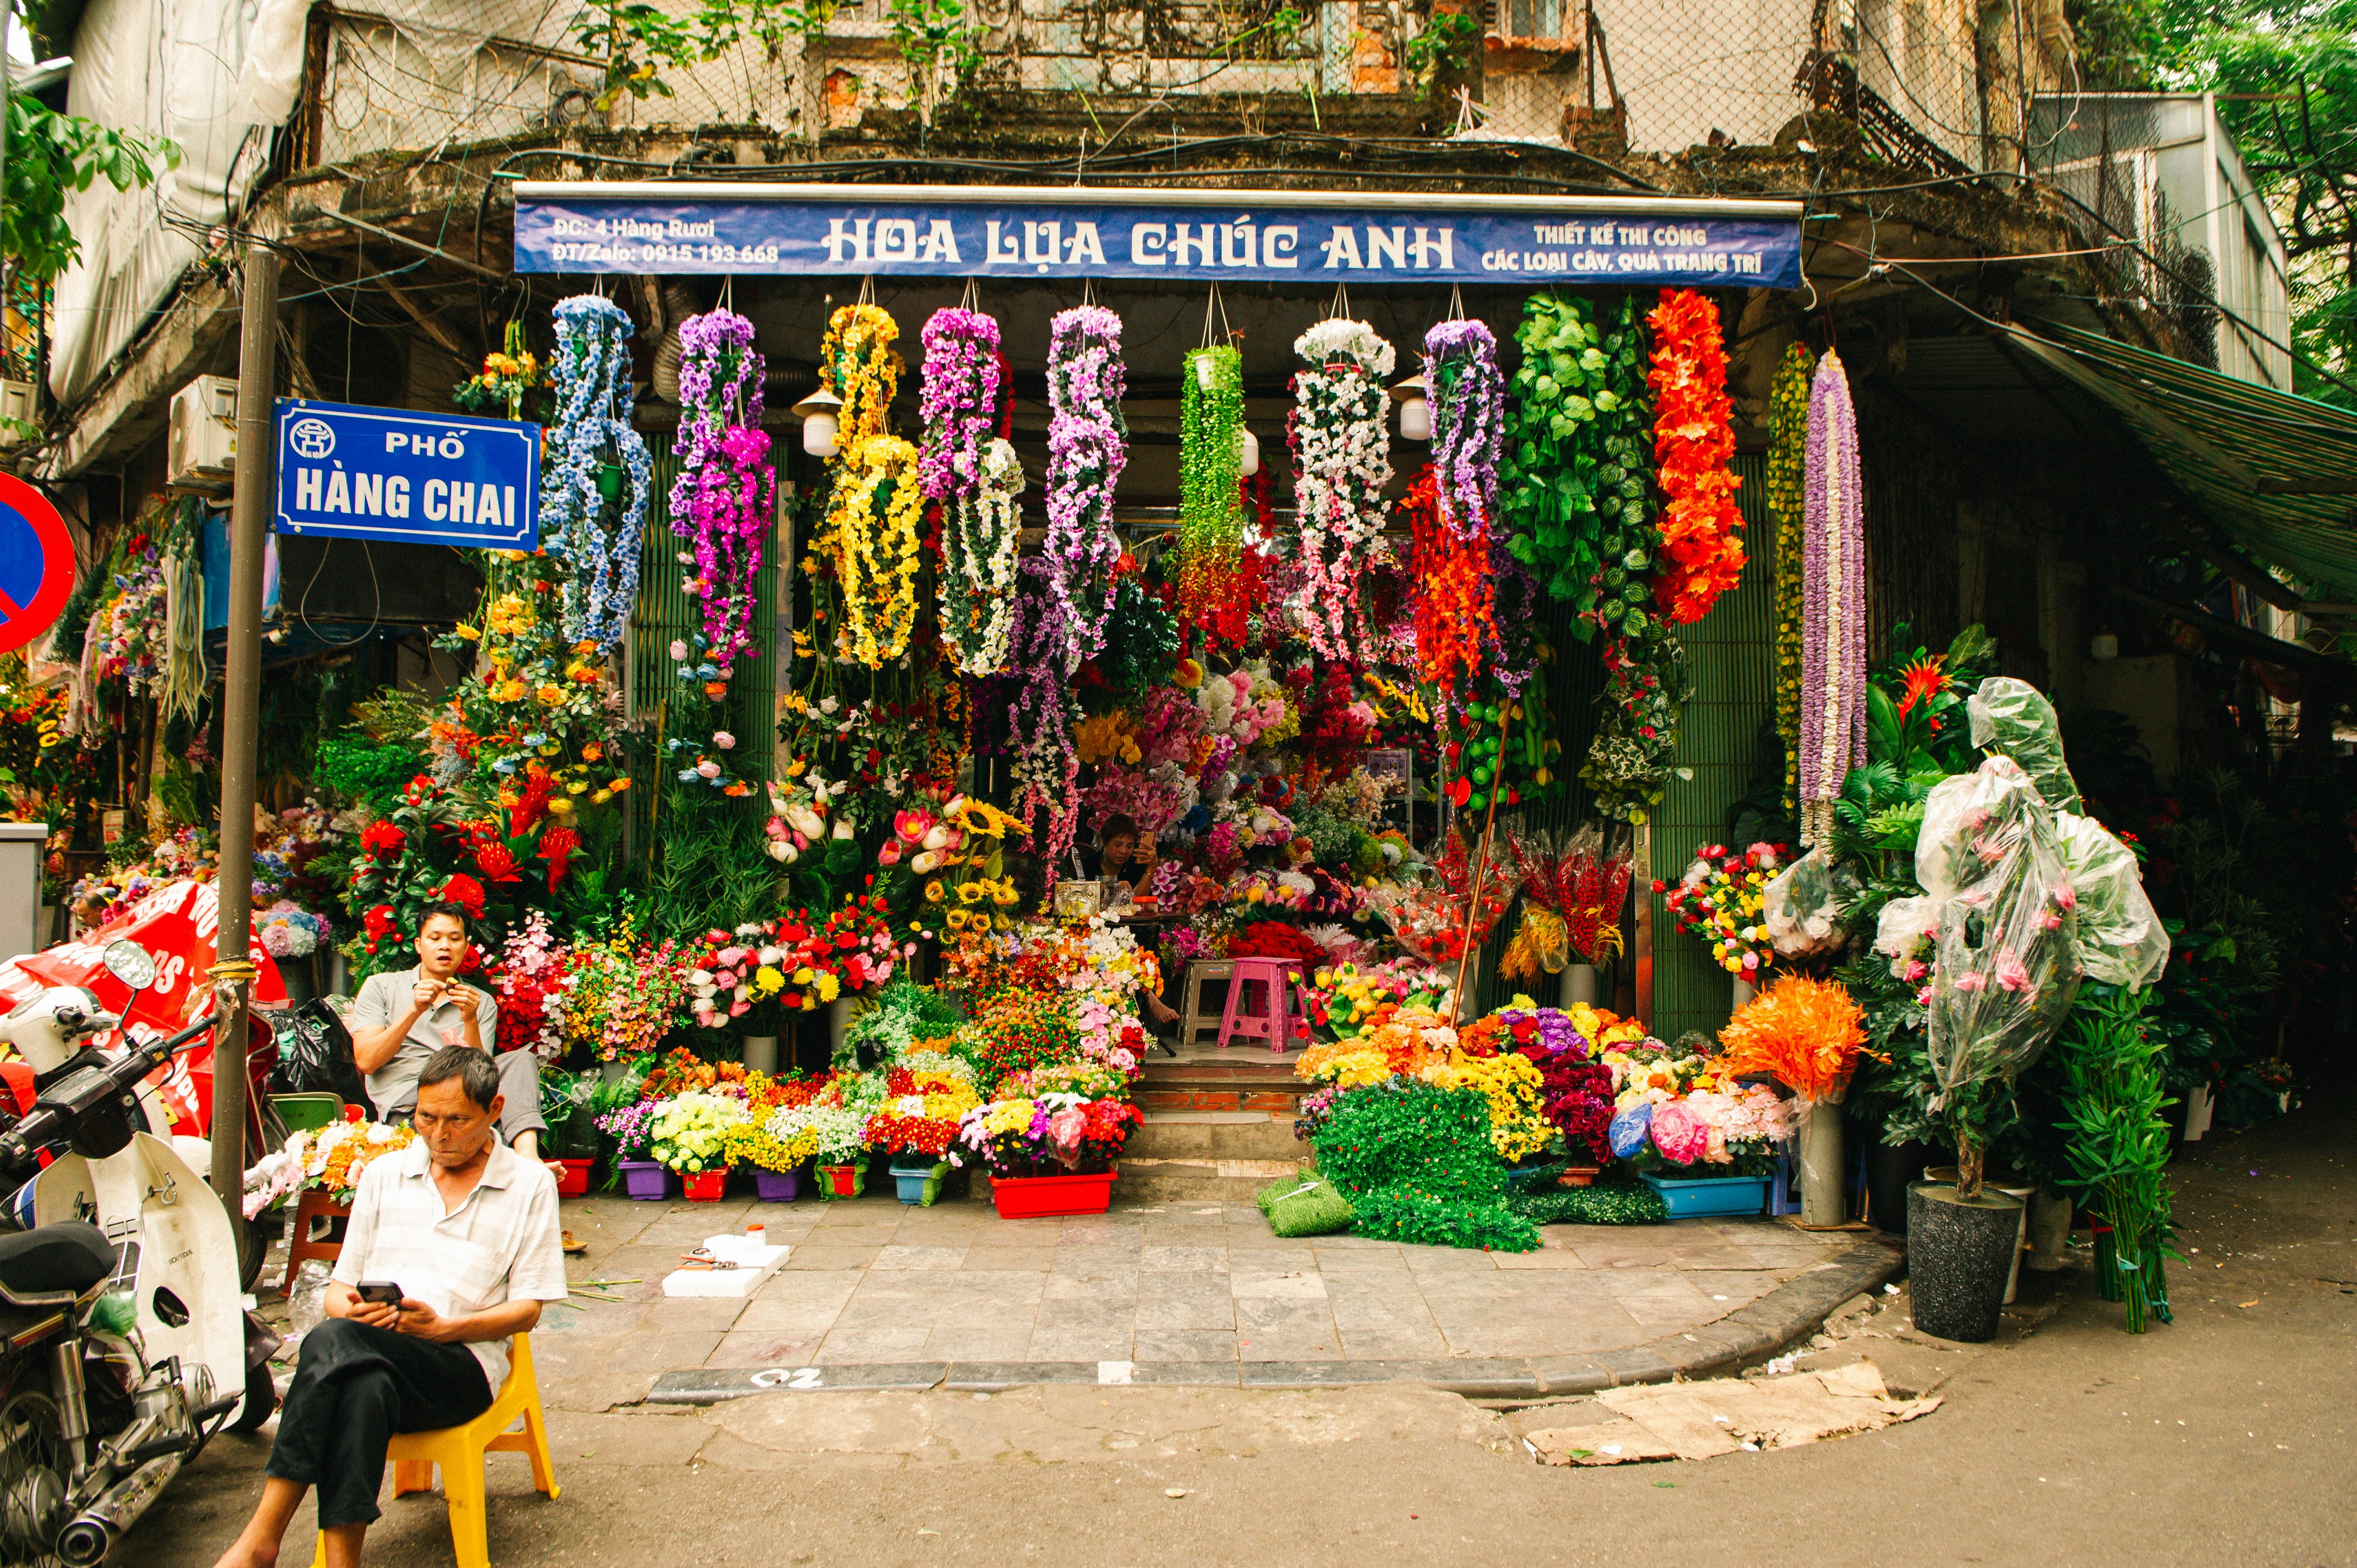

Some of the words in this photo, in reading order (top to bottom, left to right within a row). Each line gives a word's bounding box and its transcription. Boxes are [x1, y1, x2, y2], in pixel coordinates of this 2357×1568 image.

[553, 219, 589, 236] ĐC:
[594, 219, 607, 236] 4
[613, 218, 664, 241] Hàng
[669, 219, 715, 237] Rươi
[1533, 220, 1586, 245] THIẾT
[1591, 221, 1618, 245] KẾ
[1618, 226, 1648, 246] THI
[1653, 225, 1706, 246] CÔNG
[552, 243, 636, 262] ĐT/Zalo:
[642, 244, 693, 262] 0915
[699, 244, 735, 263] 193
[741, 245, 779, 263] 668
[821, 218, 961, 263] HOA
[985, 220, 1107, 274] LỤA
[1131, 214, 1298, 267] CHÚC
[1320, 225, 1455, 269] ANH
[1481, 249, 1519, 271] CÁC
[1524, 252, 1567, 272] LOẠI
[1572, 249, 1614, 272] CÂY,
[1663, 253, 1727, 273] TRANG
[1732, 251, 1763, 274] TRÍ
[385, 430, 469, 459] PHỐ
[296, 460, 410, 518] HÀNG
[423, 478, 515, 527] CHAI
[750, 1368, 824, 1389] 02
